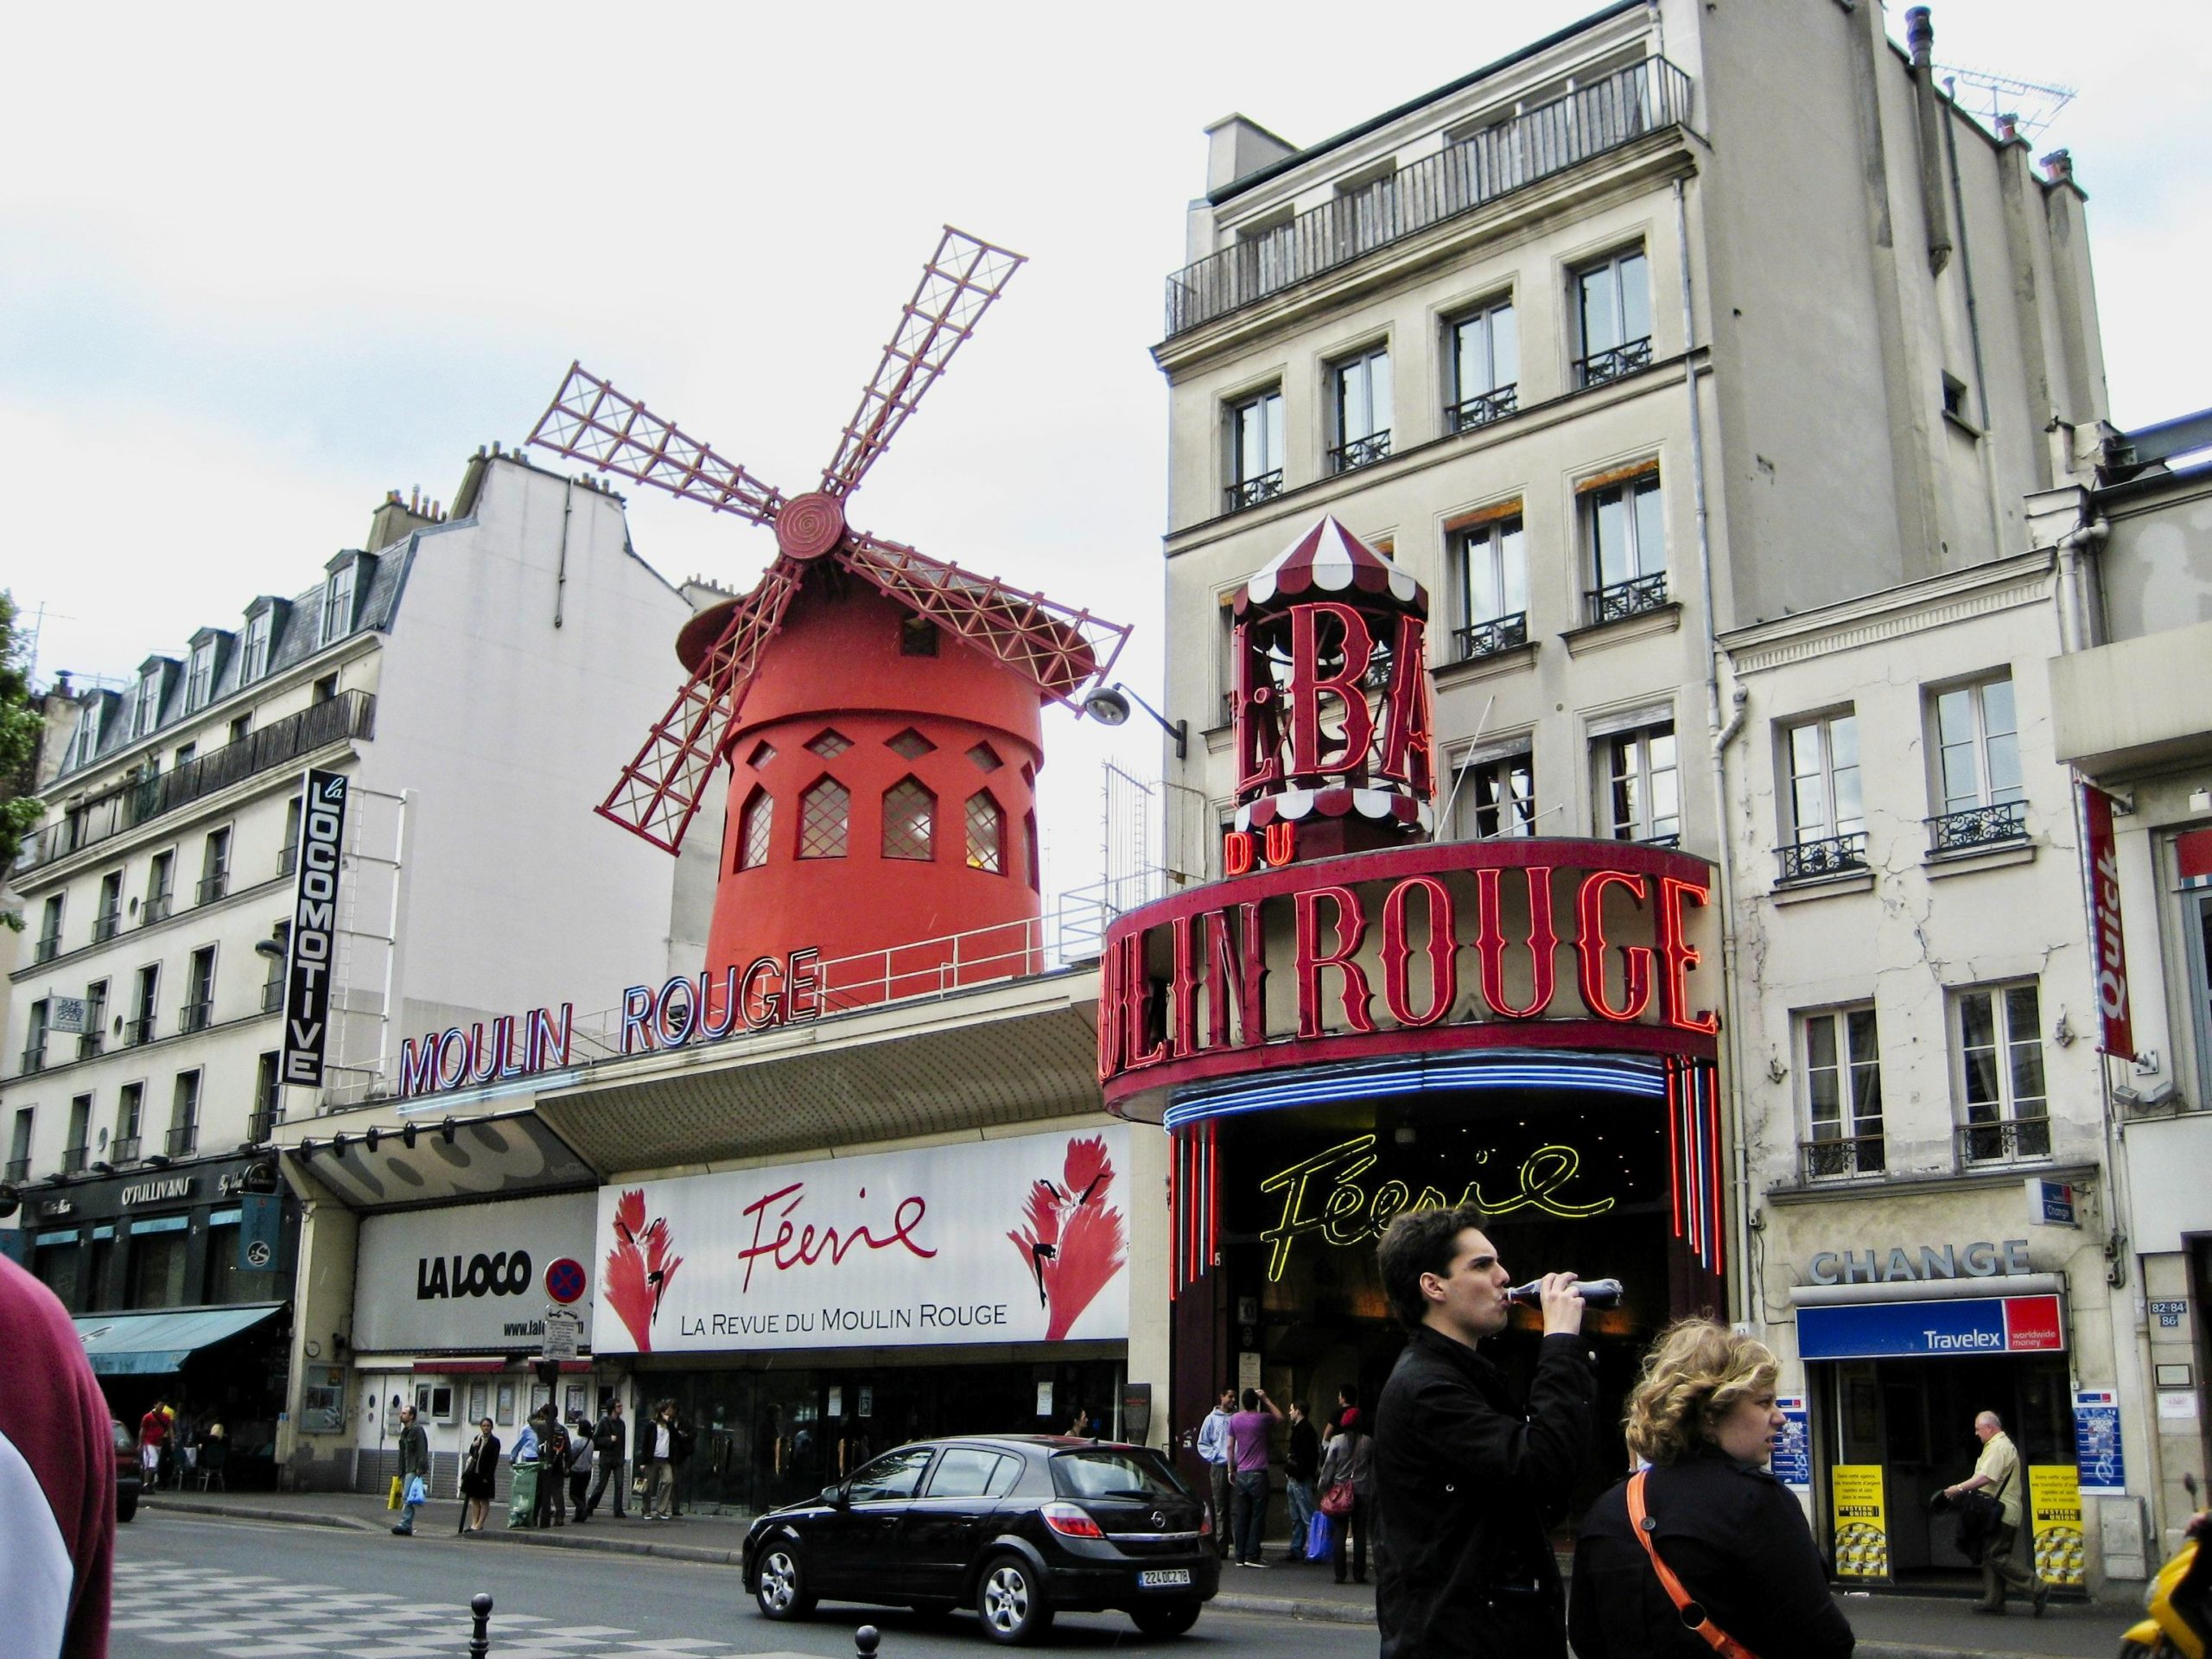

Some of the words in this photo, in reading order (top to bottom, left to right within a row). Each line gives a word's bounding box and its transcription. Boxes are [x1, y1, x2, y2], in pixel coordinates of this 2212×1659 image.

[1224, 822, 1294, 875] DU
[288, 782, 341, 1080] LOCOMOTIVE
[1294, 865, 1719, 1038] ROUGE
[2098, 846, 2126, 1021] Quick
[398, 1002, 573, 1096] MOULIN
[620, 947, 819, 1055] ROUGE
[738, 1182, 938, 1294] Féerie
[1809, 1239, 2031, 1285] CHANGE
[1923, 1329, 2000, 1349] Travelex
[2012, 1330, 2056, 1339] worldwide
[2012, 1339, 2041, 1348] money
[2162, 1316, 2176, 1325] 86
